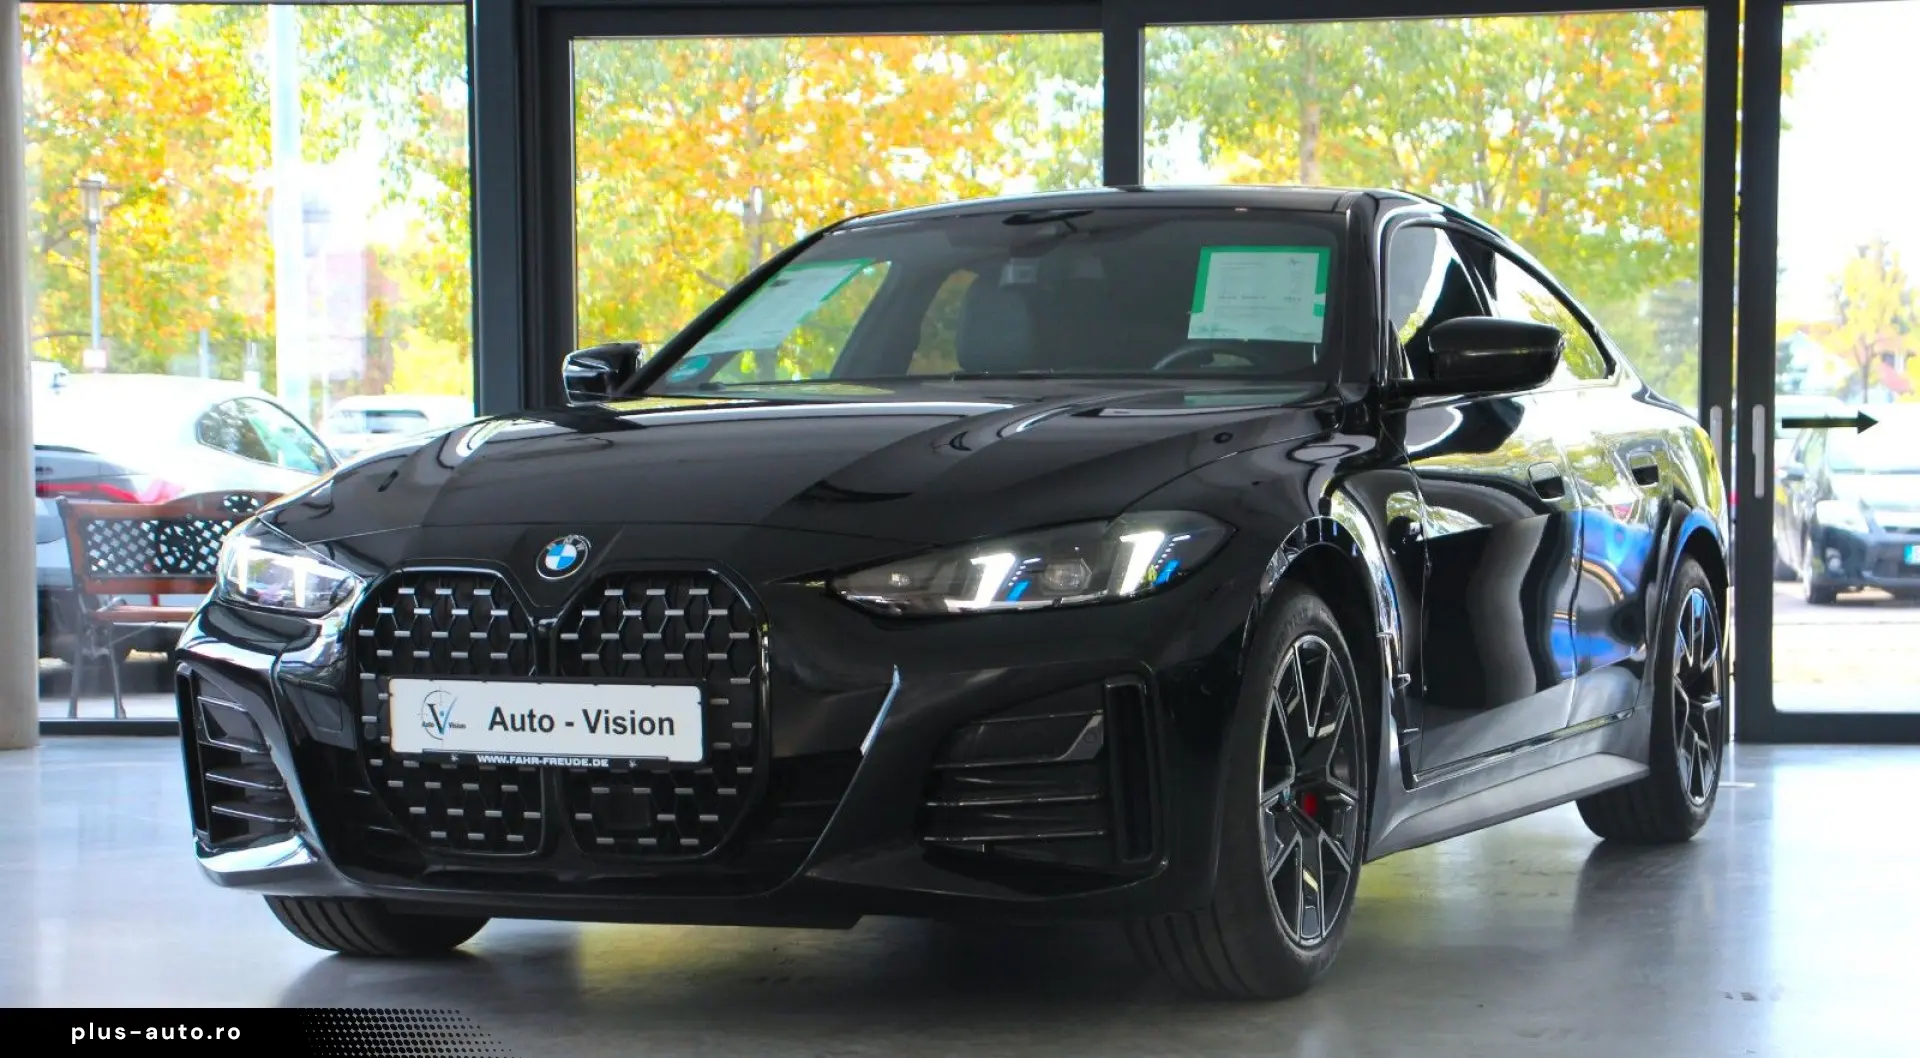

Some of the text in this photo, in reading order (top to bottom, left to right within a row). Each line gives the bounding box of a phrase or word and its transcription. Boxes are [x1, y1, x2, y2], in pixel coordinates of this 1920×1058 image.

[488, 706, 555, 733] Auto
[582, 709, 675, 736] Vision
[476, 754, 609, 768] WWW.FAHR-FREUDE.DE
